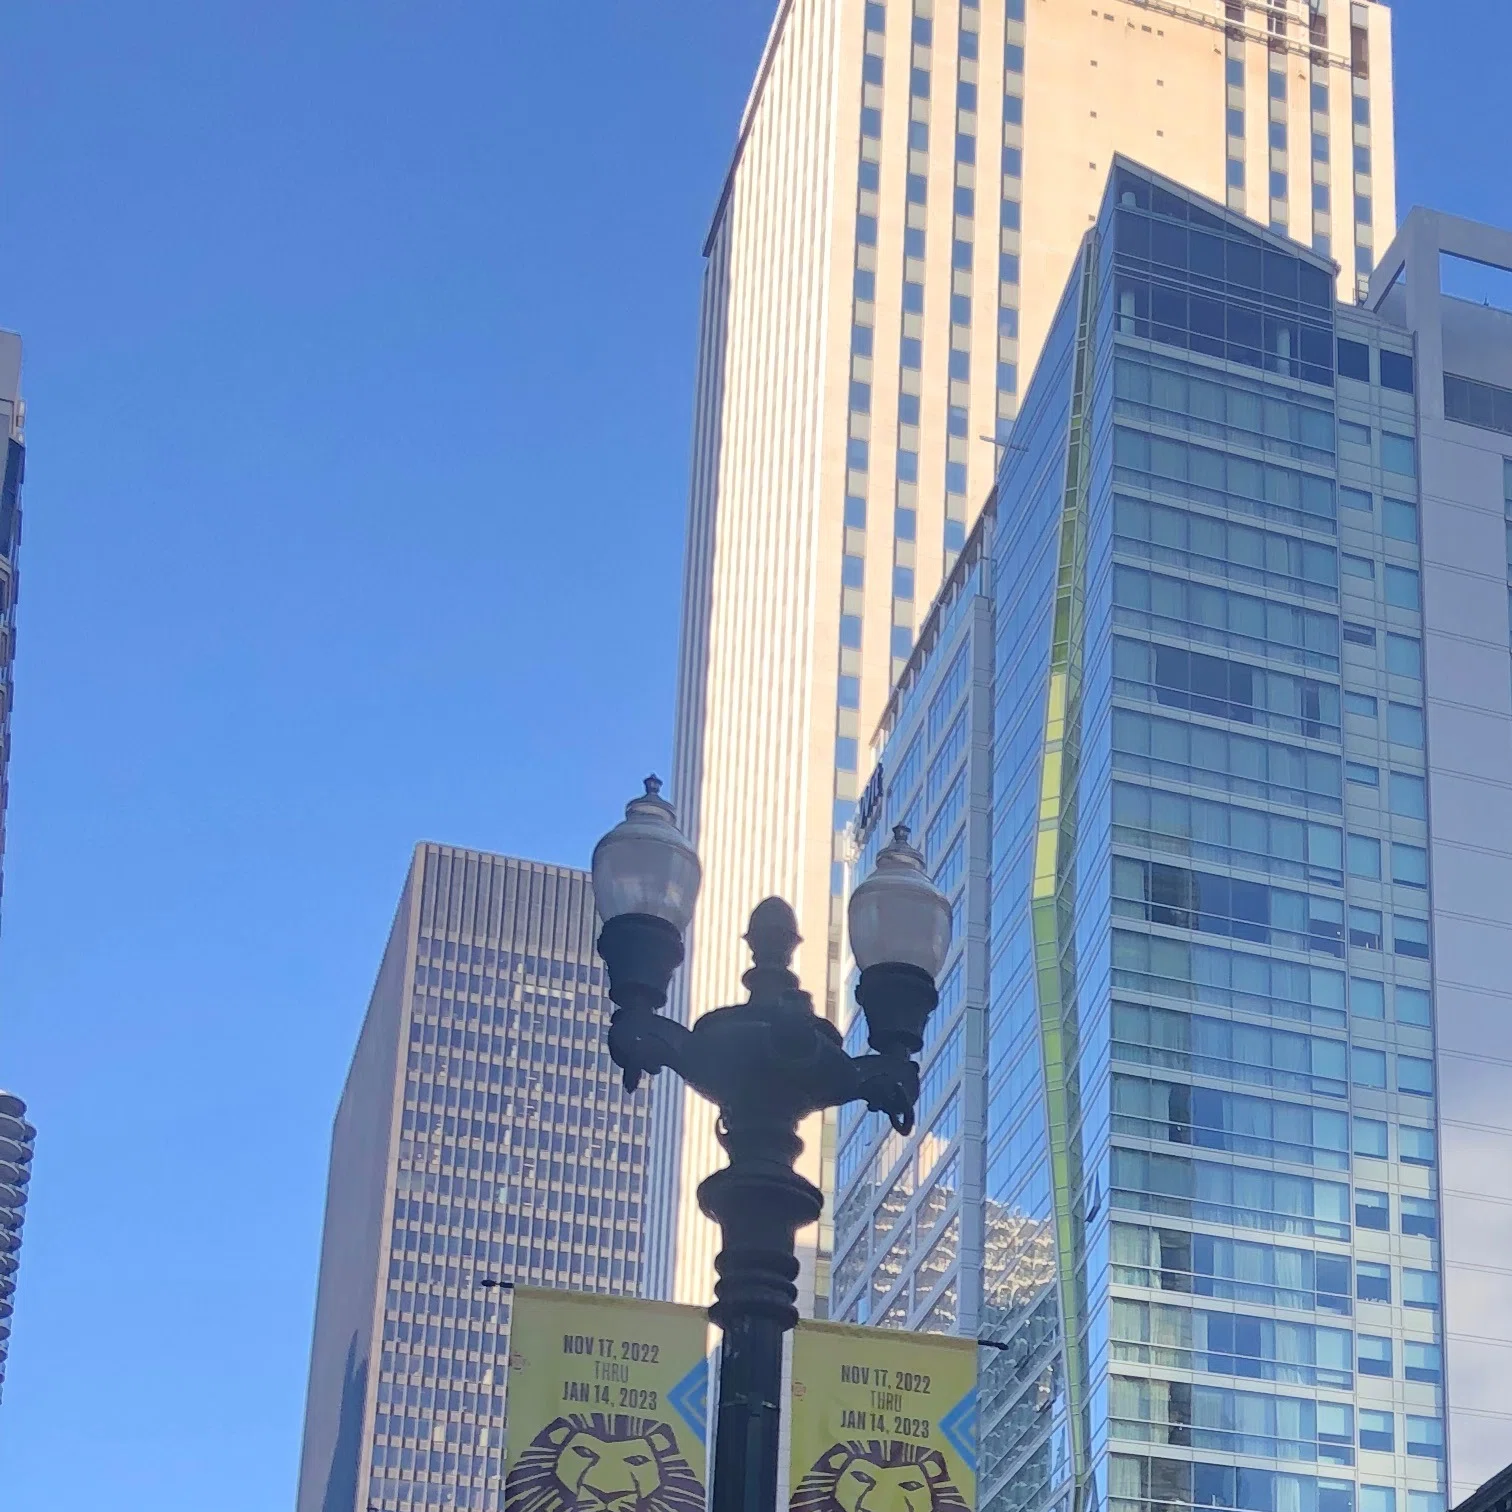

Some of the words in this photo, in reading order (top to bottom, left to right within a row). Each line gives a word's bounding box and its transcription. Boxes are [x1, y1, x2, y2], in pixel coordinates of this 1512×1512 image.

[563, 1334, 594, 1355] NOV
[598, 1339, 617, 1361] 17,
[621, 1341, 660, 1364] 2022
[594, 1360, 629, 1383] THRU
[841, 1365, 869, 1385] NOV
[873, 1369, 892, 1389] 17,
[896, 1371, 931, 1394] 2022
[562, 1381, 590, 1402] JAN
[594, 1385, 615, 1408] 14,
[619, 1387, 658, 1410] 2023
[870, 1390, 902, 1413] THRU
[840, 1410, 866, 1431] JAN
[870, 1413, 890, 1435] 14,
[894, 1416, 929, 1439] 2023
